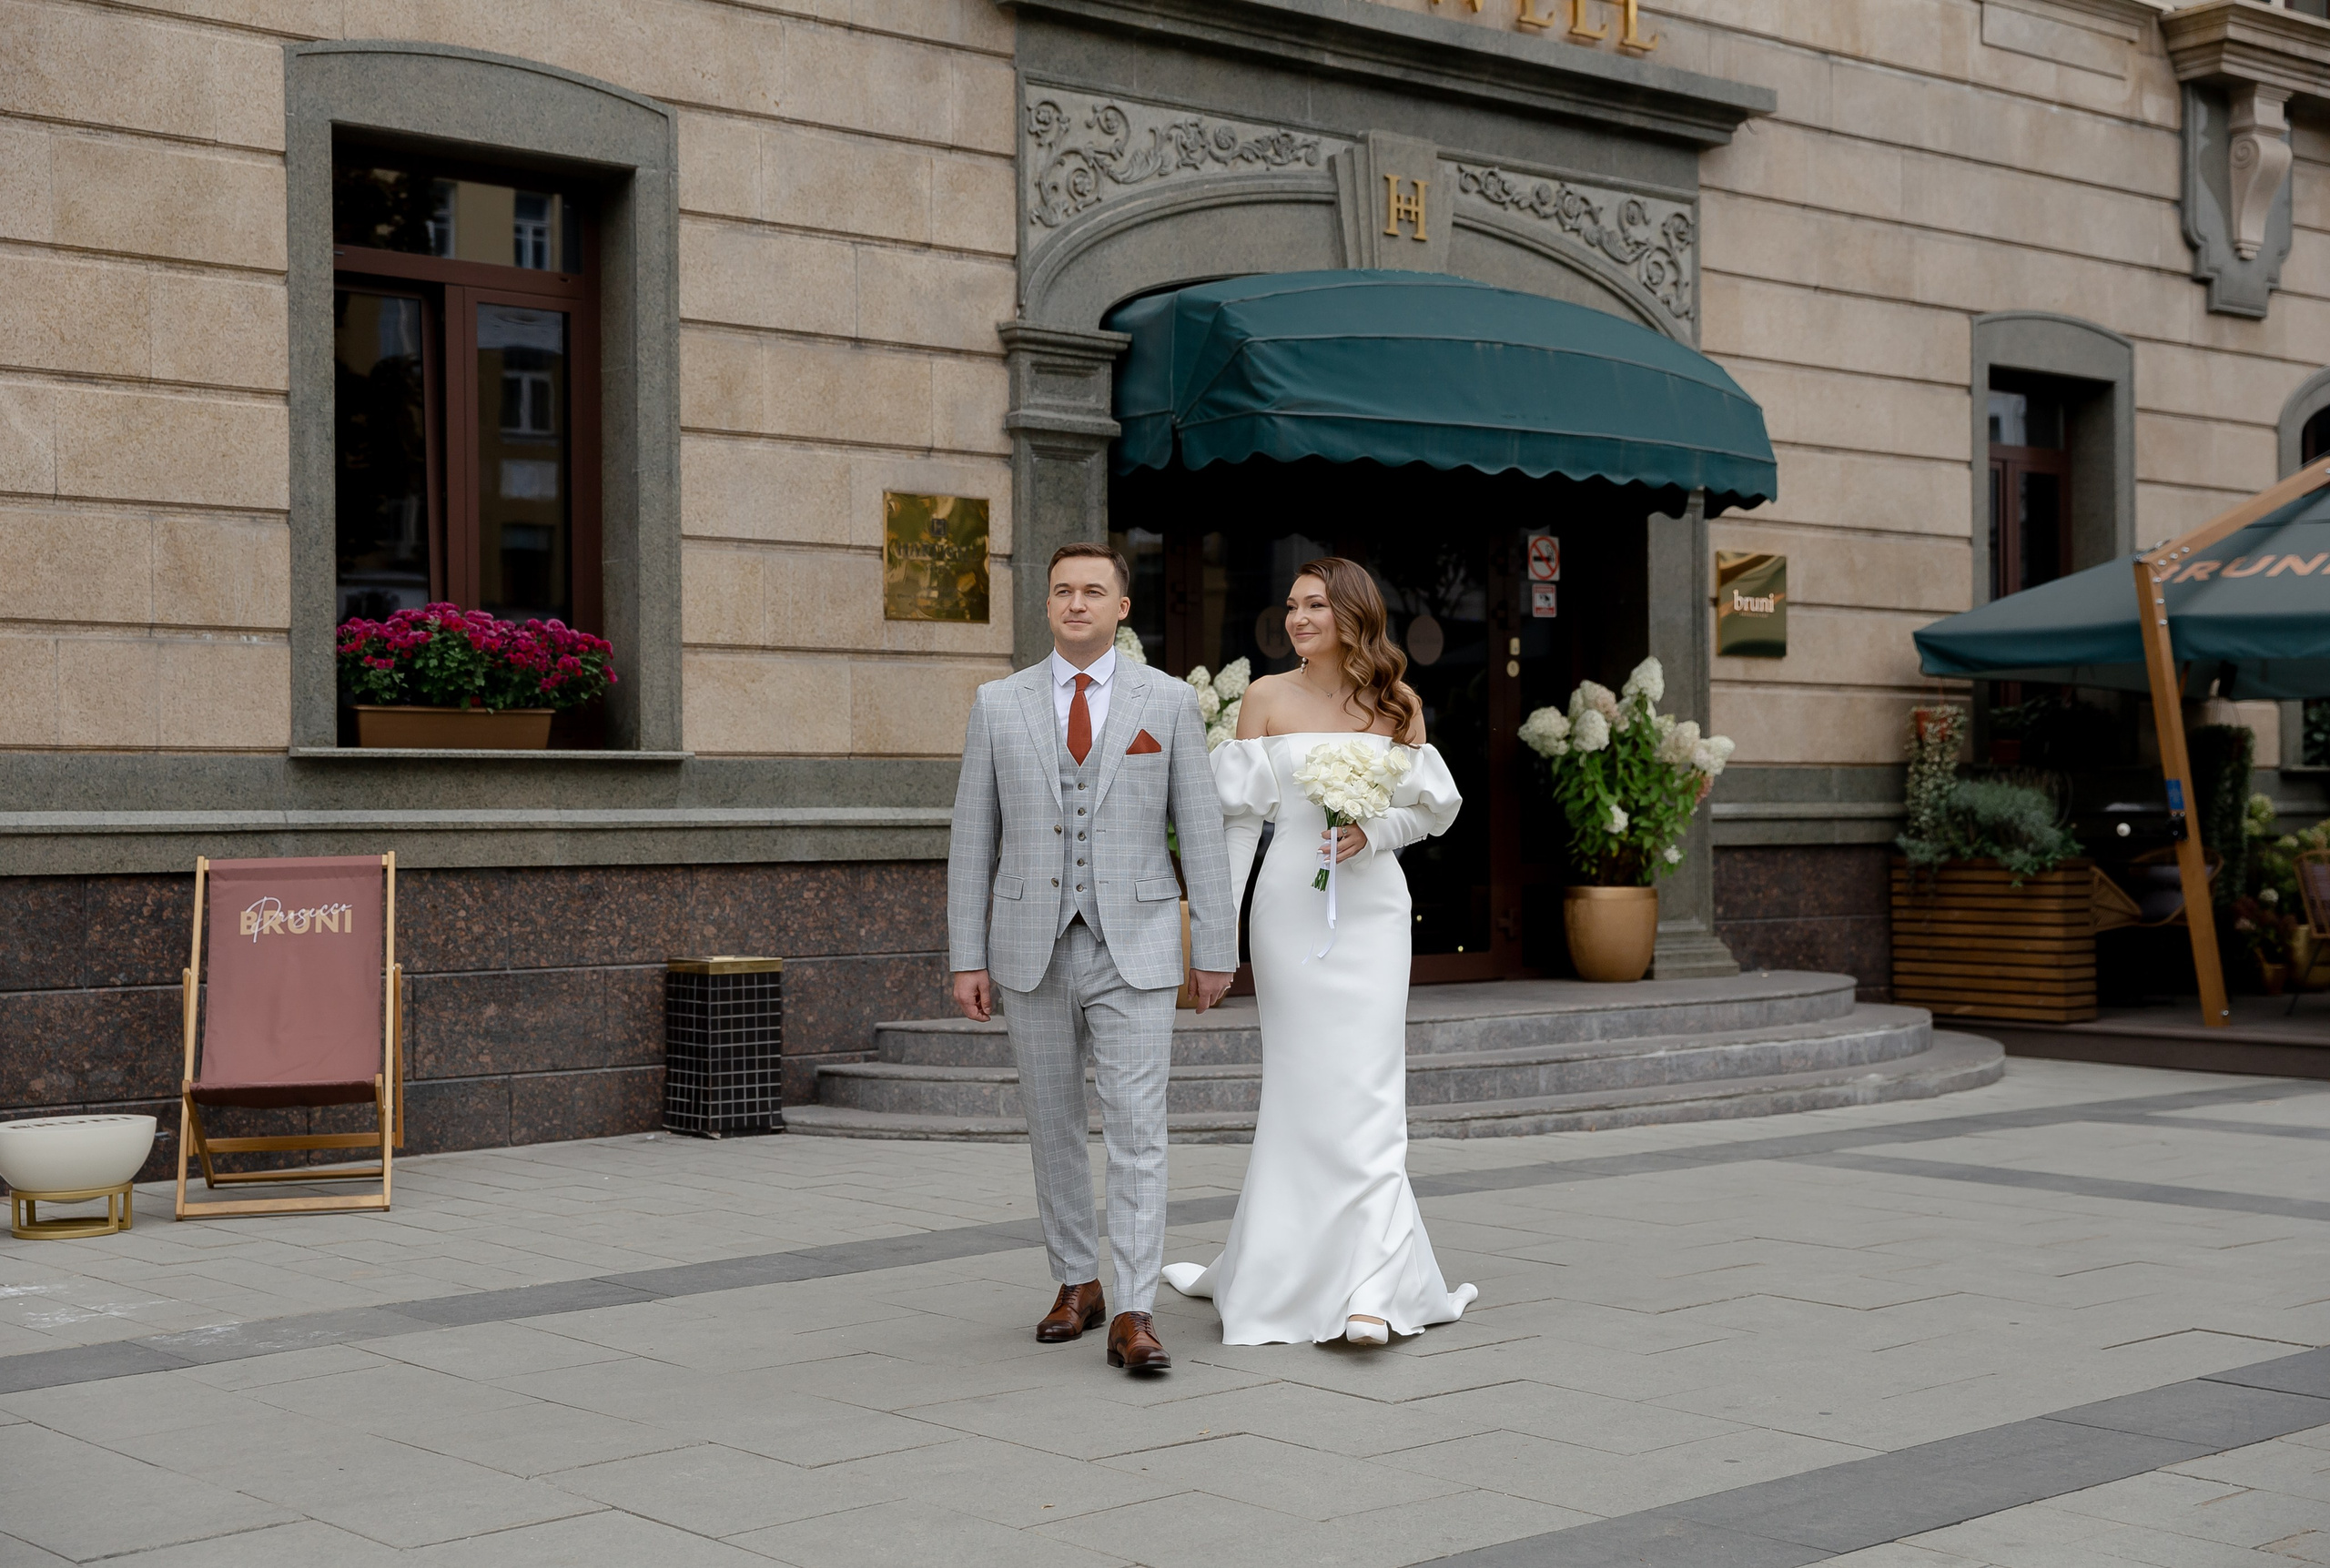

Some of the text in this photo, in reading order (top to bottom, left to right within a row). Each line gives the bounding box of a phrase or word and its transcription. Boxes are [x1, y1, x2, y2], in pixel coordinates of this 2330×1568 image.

[1733, 589, 1775, 613] bruni
[239, 909, 353, 936] BRUNI
[245, 895, 353, 944] Prosecco
